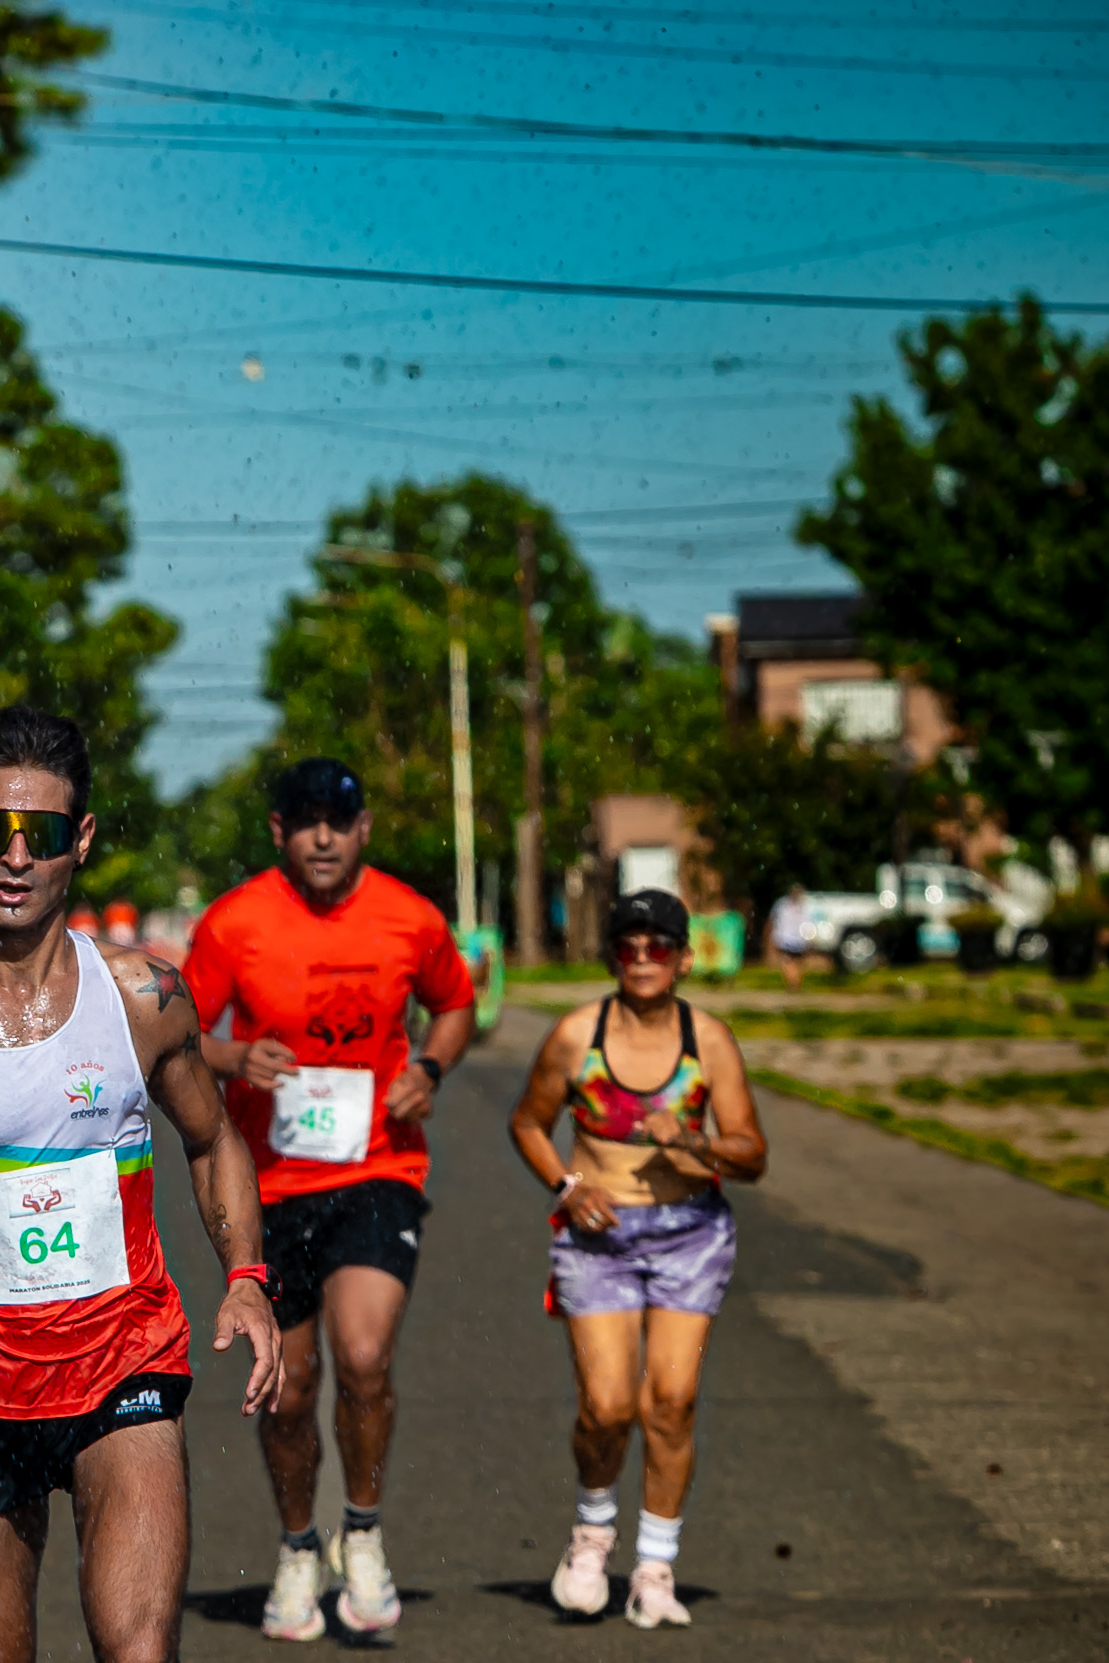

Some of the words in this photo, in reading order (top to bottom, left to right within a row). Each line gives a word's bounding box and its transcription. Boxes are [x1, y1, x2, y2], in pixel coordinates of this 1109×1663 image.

[66, 1064, 78, 1075] 10
[80, 1060, 104, 1072] años
[298, 1106, 336, 1135] 45
[19, 1221, 80, 1264] 64
